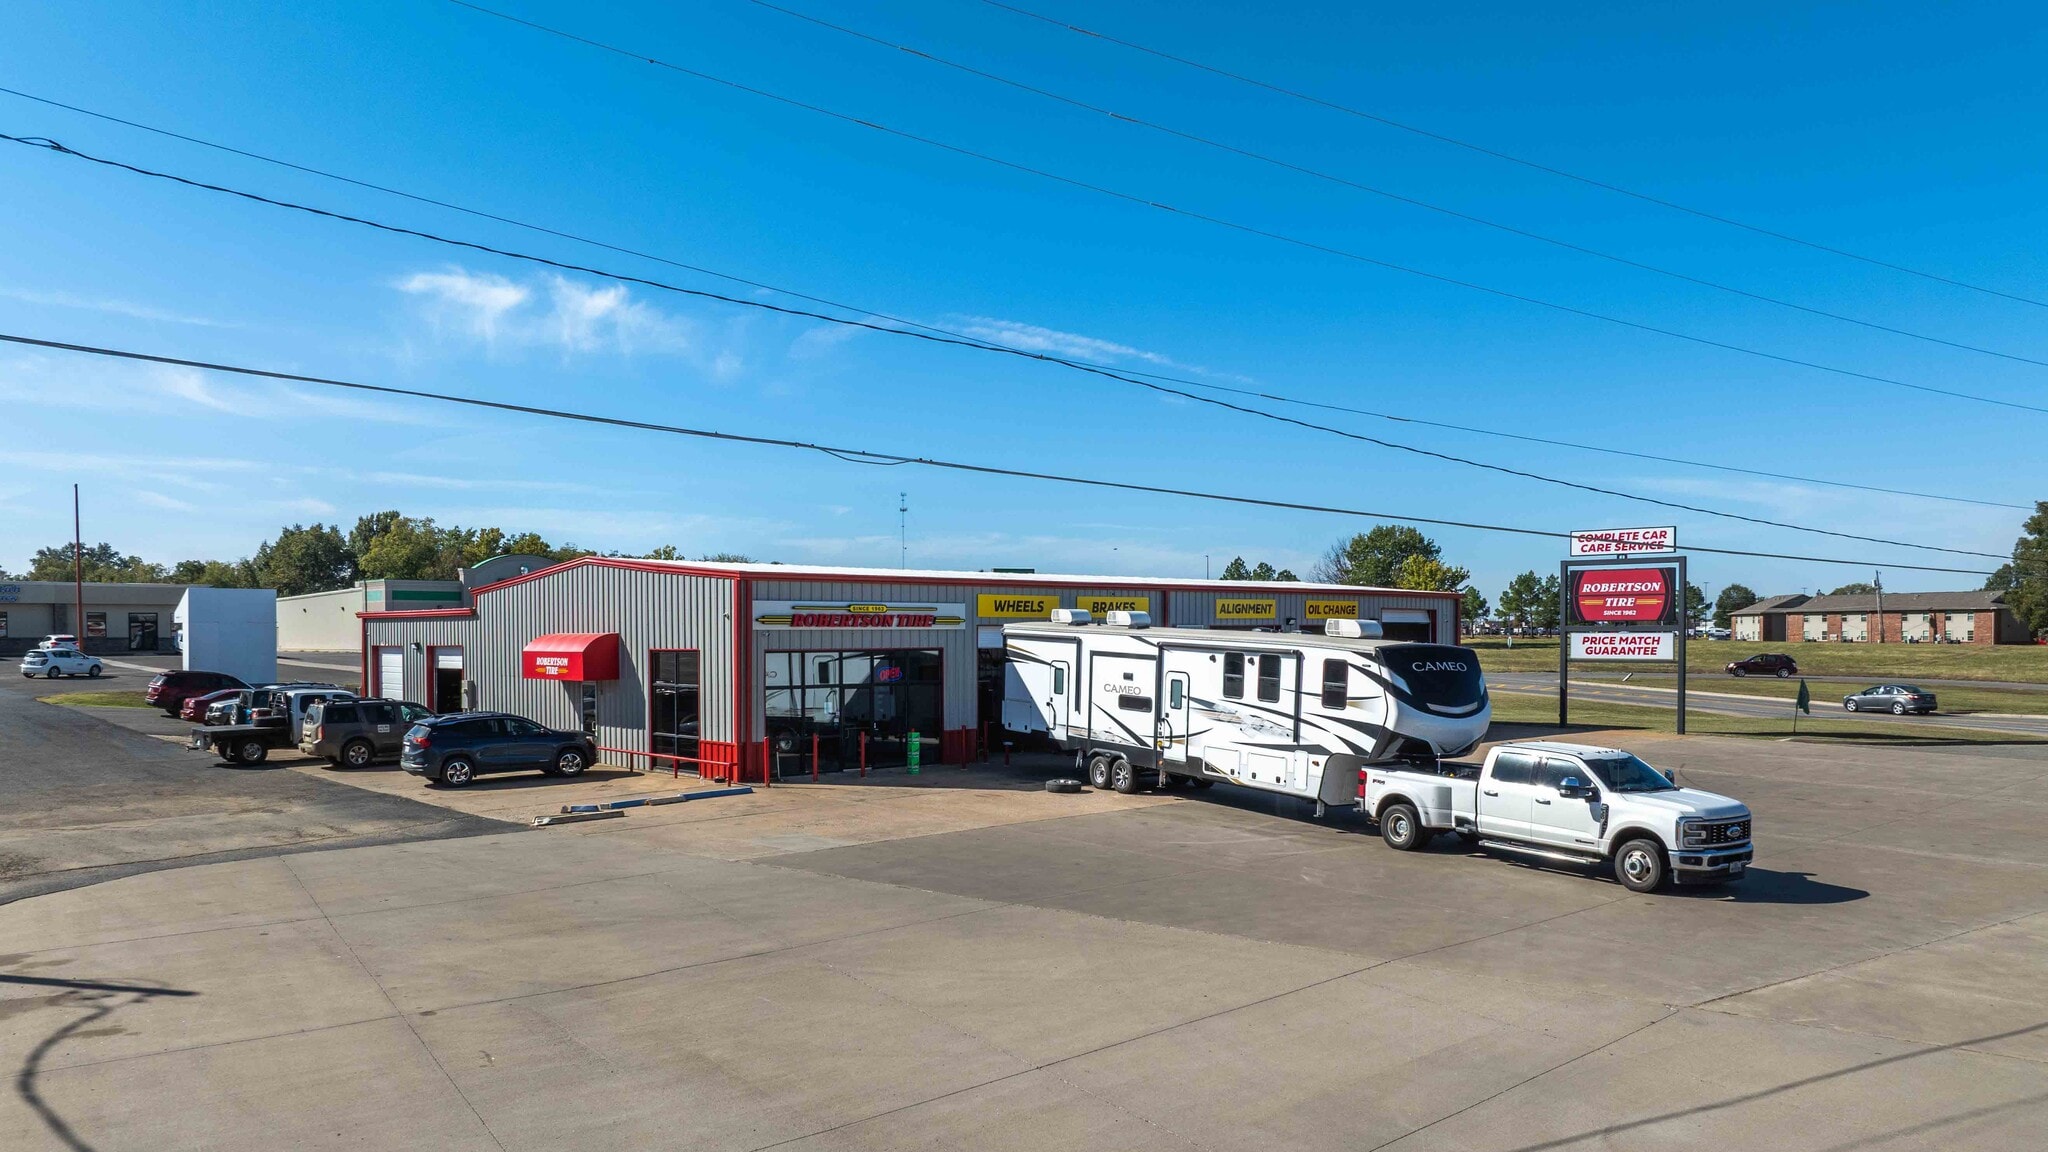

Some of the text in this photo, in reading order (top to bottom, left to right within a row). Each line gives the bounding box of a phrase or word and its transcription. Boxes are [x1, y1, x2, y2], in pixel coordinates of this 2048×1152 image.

[1577, 530, 1667, 543] COMPLETE CAR
[1581, 540, 1664, 553] CARE SERVICE
[1582, 582, 1661, 593] ROBERTSON
[993, 600, 1044, 613] WHEELS
[1092, 601, 1136, 613] BRAKES
[1605, 597, 1635, 607] TIRE
[1219, 603, 1273, 615] ALIGNMENT
[1308, 604, 1356, 615] OIL CHANGE
[790, 613, 935, 628] ROBERTSON TIRE
[1582, 636, 1660, 645] PRICE MATCH
[1585, 646, 1657, 655] GUARANTEE
[536, 657, 569, 666] ROBERTSON
[1412, 661, 1467, 672] CAMEO
[546, 666, 559, 675] TIRE
[1103, 683, 1142, 696] CAMEO
